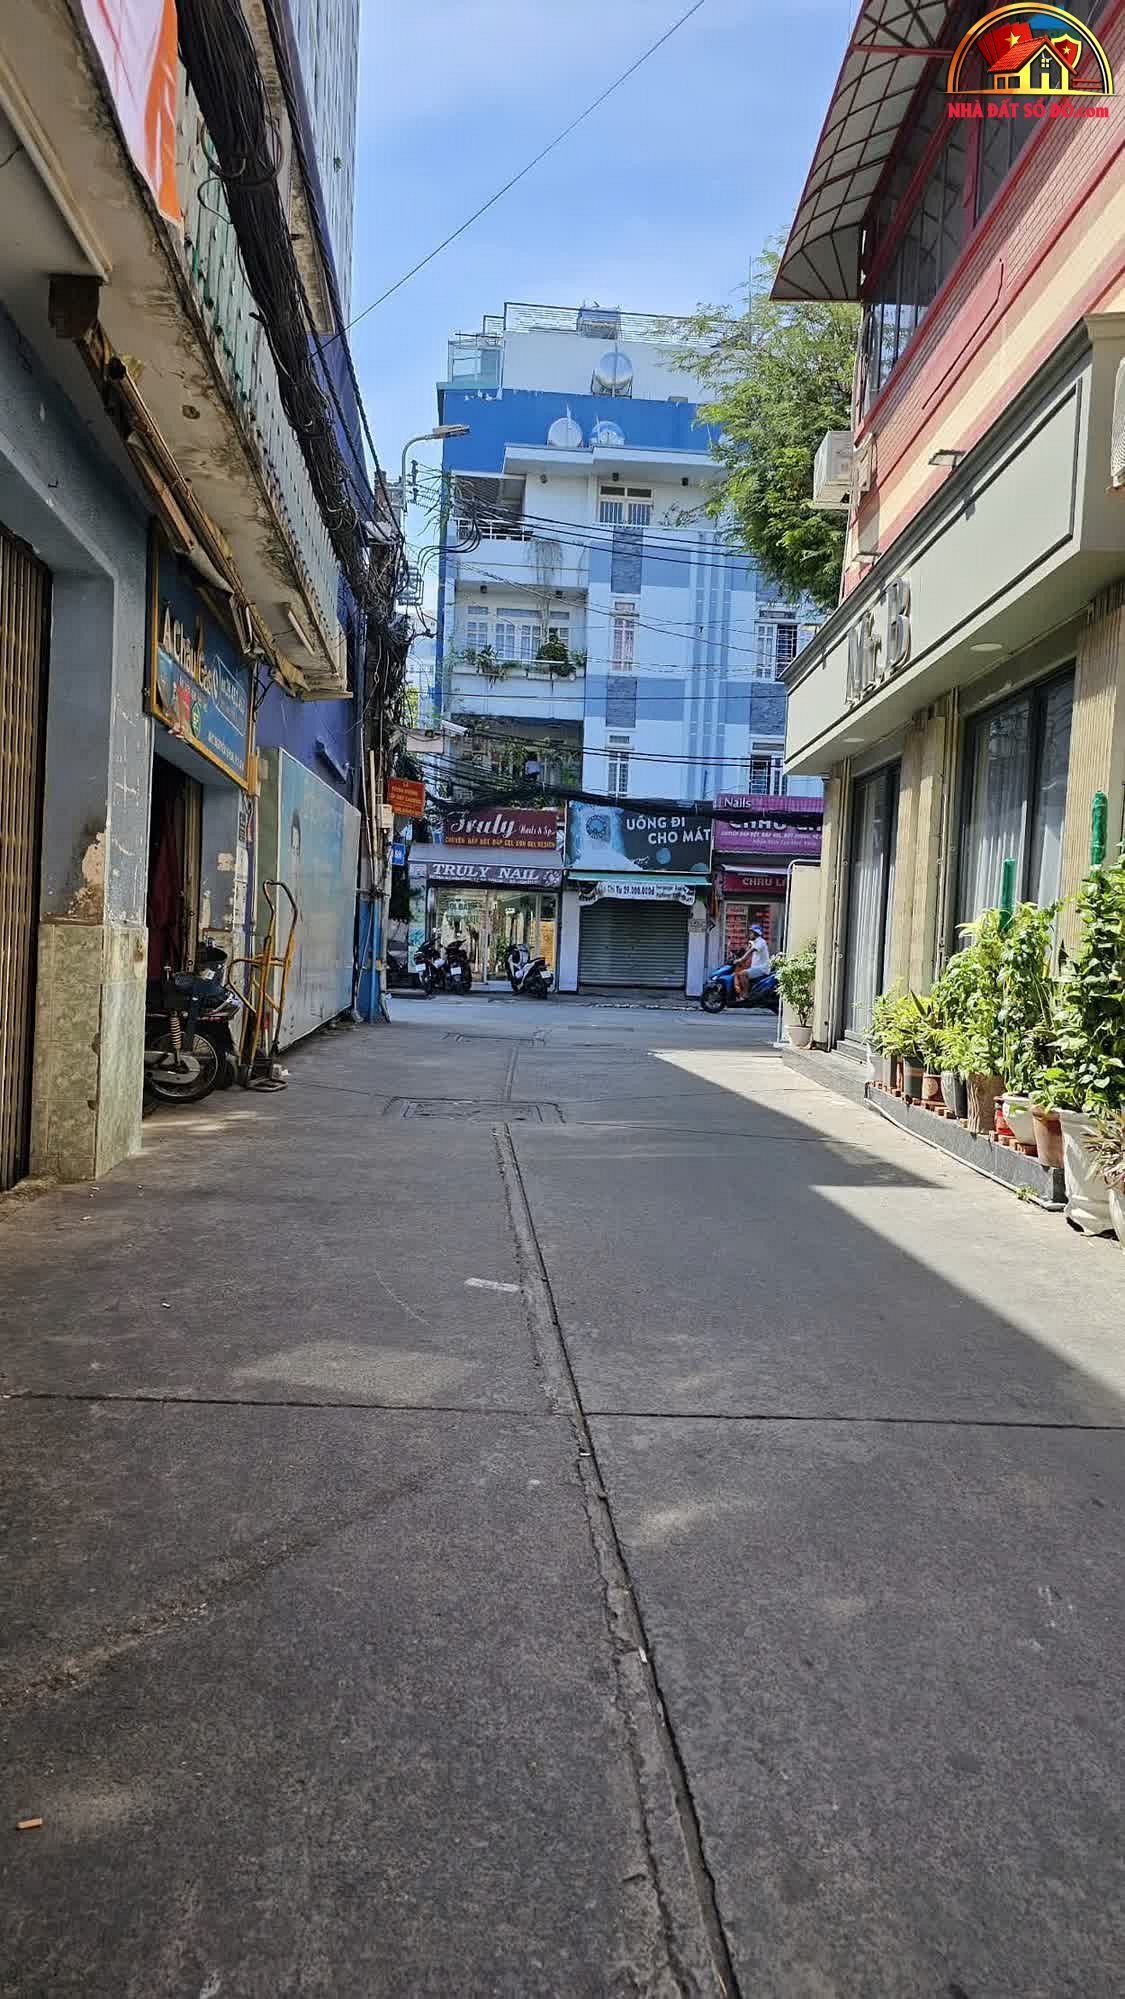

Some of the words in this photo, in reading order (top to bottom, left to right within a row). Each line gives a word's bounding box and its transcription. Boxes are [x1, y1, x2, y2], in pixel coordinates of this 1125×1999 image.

[724, 797, 752, 809] Nails
[450, 810, 517, 838] Truly
[626, 814, 667, 830] UỐNG
[671, 816, 685, 828] ĐI
[648, 832, 678, 845] CHO
[682, 826, 711, 842] MÁT
[432, 863, 490, 878] TRULY
[498, 868, 539, 880] NAIL
